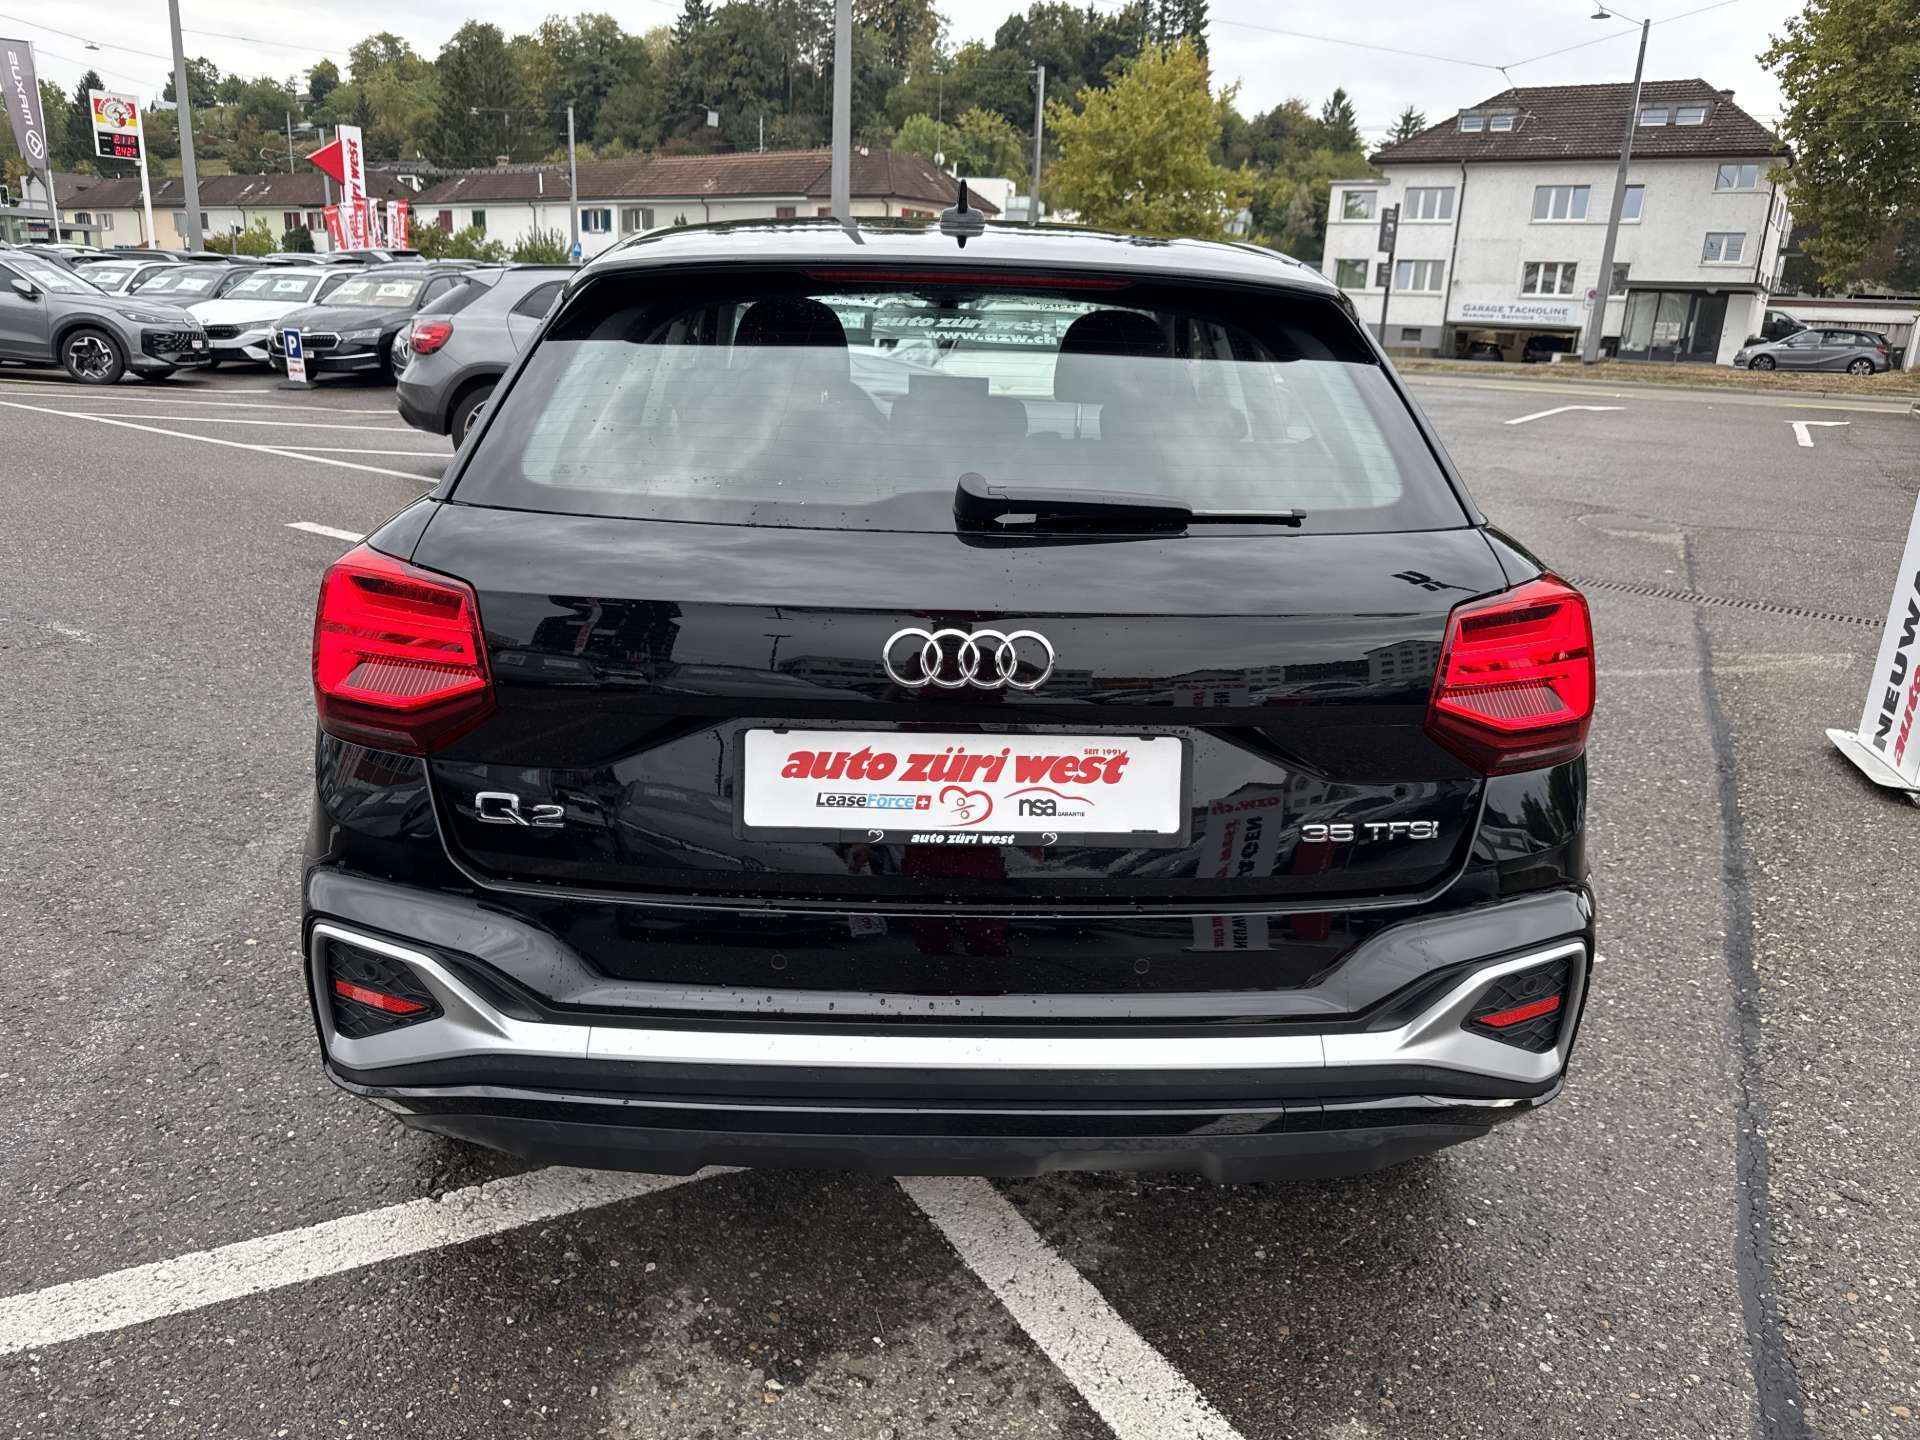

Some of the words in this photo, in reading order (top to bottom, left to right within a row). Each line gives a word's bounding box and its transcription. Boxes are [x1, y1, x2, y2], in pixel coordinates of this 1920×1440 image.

[287, 334, 297, 355] P
[781, 745, 898, 781] auto
[898, 746, 1011, 783] züri
[1015, 750, 1130, 785] west
[475, 791, 565, 828] Q2
[816, 792, 916, 809] LeaseForce
[1018, 799, 1057, 817] nsa
[911, 833, 944, 844] auto
[946, 832, 977, 845] züri
[982, 834, 1015, 845] west
[1302, 824, 1354, 843] 35
[1364, 820, 1439, 841] TFSI
